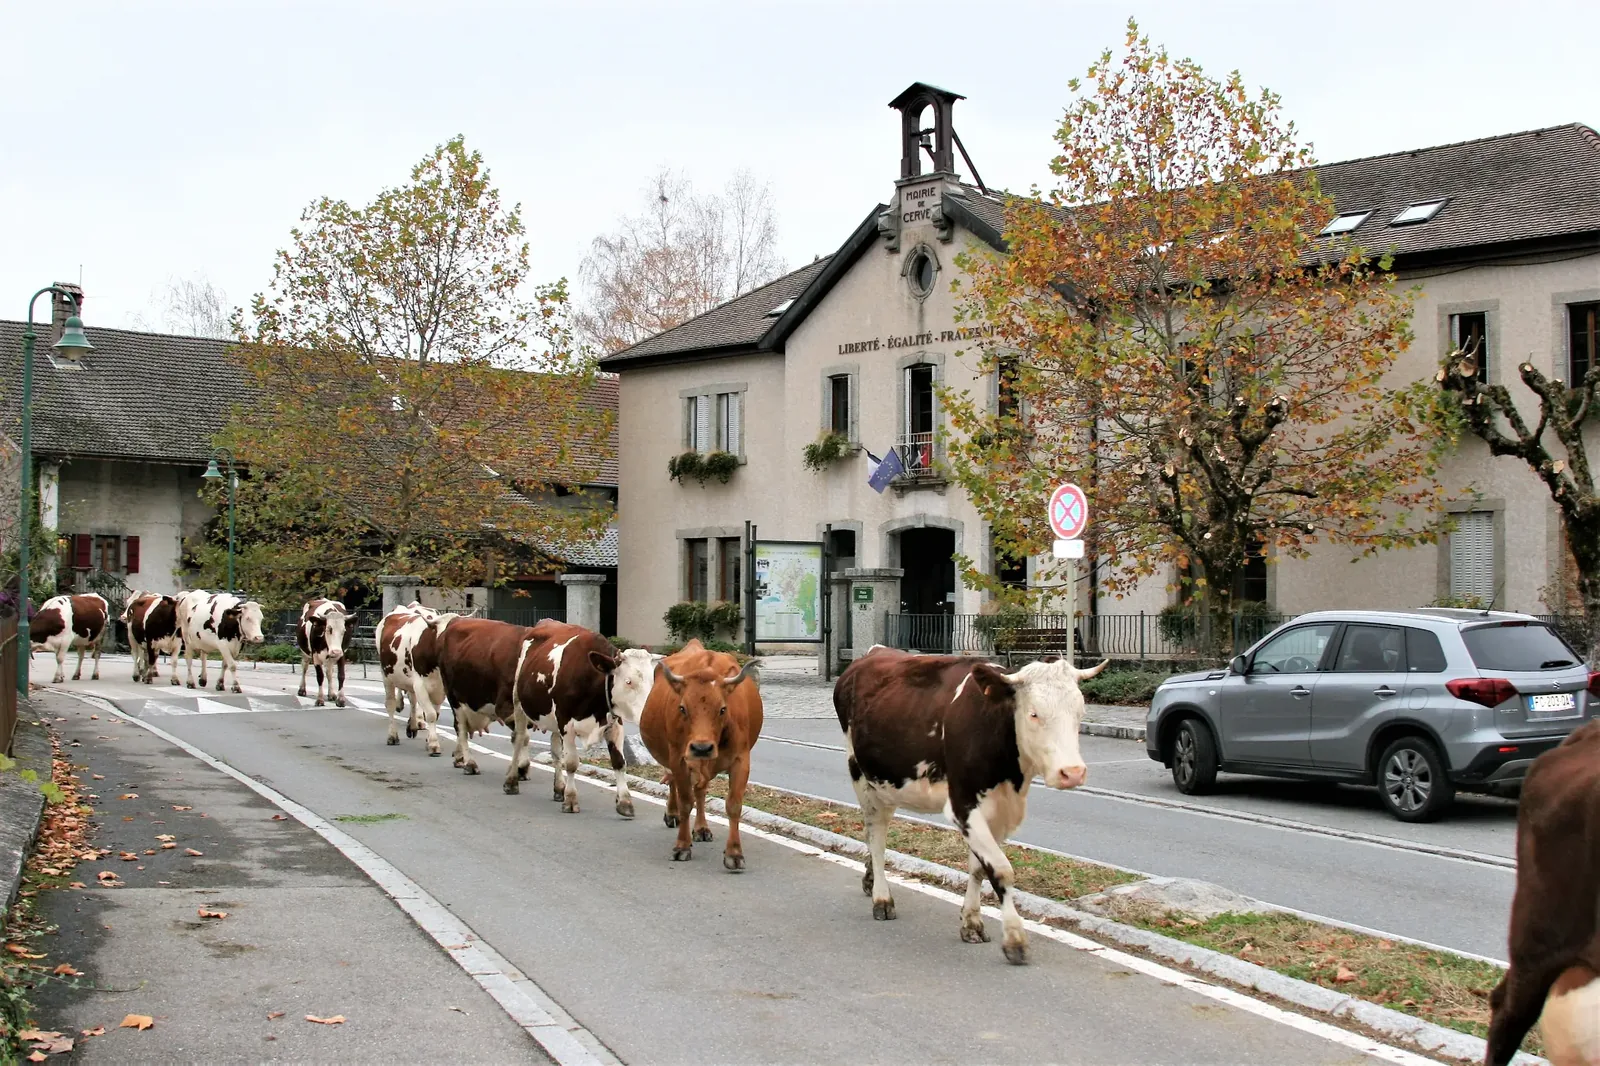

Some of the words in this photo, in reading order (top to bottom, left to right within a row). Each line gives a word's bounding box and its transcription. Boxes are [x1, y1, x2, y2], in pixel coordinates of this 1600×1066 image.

[906, 187, 936, 201] MAIRIE
[838, 337, 880, 355] LIBERTÉ
[887, 330, 933, 349] ÉGALITÉ
